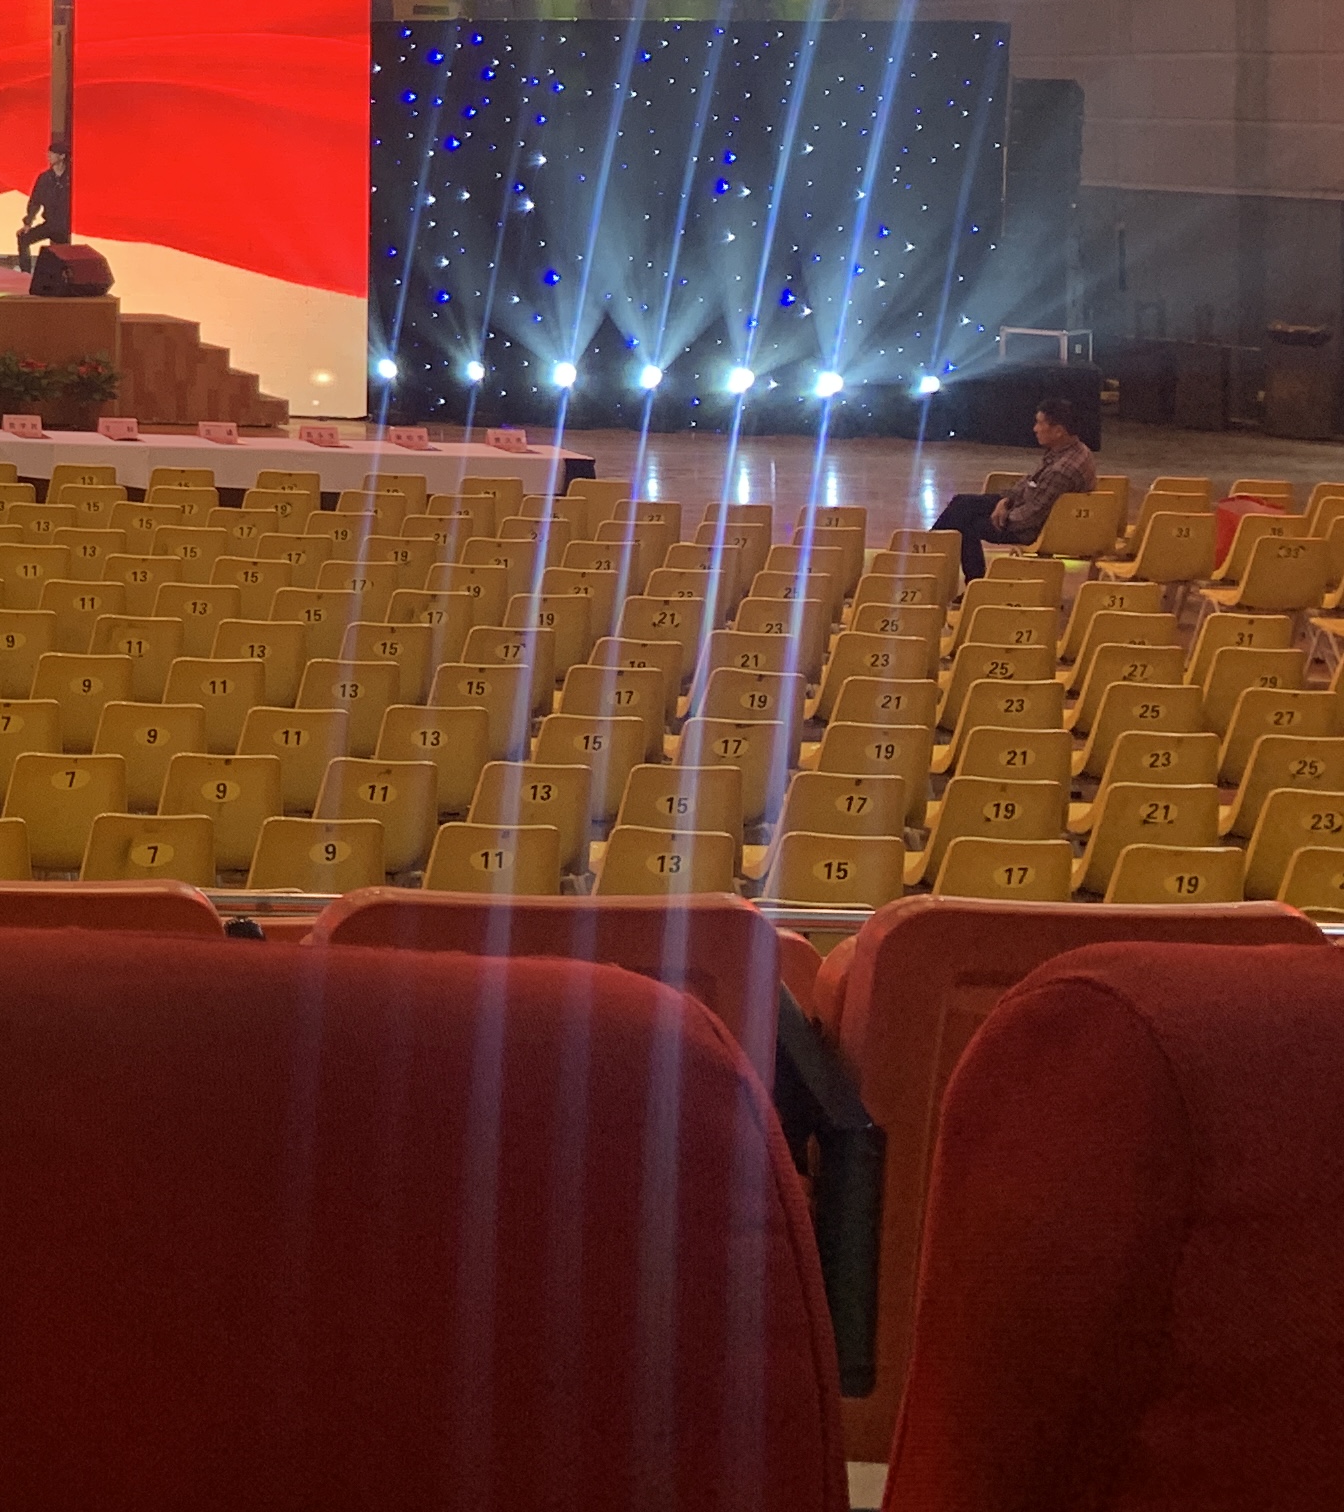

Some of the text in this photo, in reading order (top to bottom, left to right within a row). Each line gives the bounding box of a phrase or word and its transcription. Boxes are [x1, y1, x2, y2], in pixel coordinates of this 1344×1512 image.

[81, 476, 93, 485] 13
[1076, 509, 1089, 518] 33
[139, 518, 152, 529] 15
[239, 527, 252, 537] 17
[394, 550, 408, 561] 19
[23, 565, 37, 576] 11
[132, 571, 147, 582] 13
[244, 571, 258, 583] 15
[351, 579, 366, 591] 17
[80, 597, 95, 609] 11
[192, 602, 207, 615] 13
[1108, 595, 1124, 608] 31
[305, 609, 321, 621] 15
[428, 612, 443, 624] 17
[658, 613, 675, 624] 21
[6, 635, 15, 648] 9
[1015, 630, 1032, 645] 27
[125, 640, 142, 654] 11
[249, 645, 266, 658] 13
[381, 642, 398, 656] 15
[504, 645, 520, 658] 17
[741, 654, 758, 669] 21
[989, 662, 1008, 675] 25
[210, 680, 226, 694] 11
[341, 684, 359, 698] 13
[467, 681, 485, 695] 15
[615, 691, 634, 705] 17
[749, 694, 767, 709] 19
[881, 695, 901, 709] 21
[1004, 699, 1024, 713] 23
[1139, 704, 1160, 719] 25
[2, 716, 11, 731] 7
[1274, 711, 1294, 725] 27
[147, 729, 158, 744] 9
[282, 730, 301, 745] 11
[420, 731, 440, 746] 13
[583, 735, 603, 751] 15
[722, 739, 742, 754] 17
[875, 744, 895, 760] 19
[1006, 750, 1027, 766] 21
[1149, 752, 1171, 768] 23
[1296, 760, 1318, 775] 25
[216, 783, 227, 799] 9
[368, 785, 388, 802] 11
[531, 785, 552, 801] 13
[666, 797, 688, 813] 15
[846, 796, 867, 813] 17
[993, 803, 1015, 819] 19
[1146, 803, 1169, 820] 21
[1311, 813, 1334, 831] 23
[147, 846, 158, 864] 7
[325, 844, 336, 861] 9
[481, 851, 503, 869] 11
[657, 855, 682, 873] 13
[824, 862, 848, 880] 15
[1004, 867, 1028, 885] 17
[1176, 876, 1199, 894] 19
